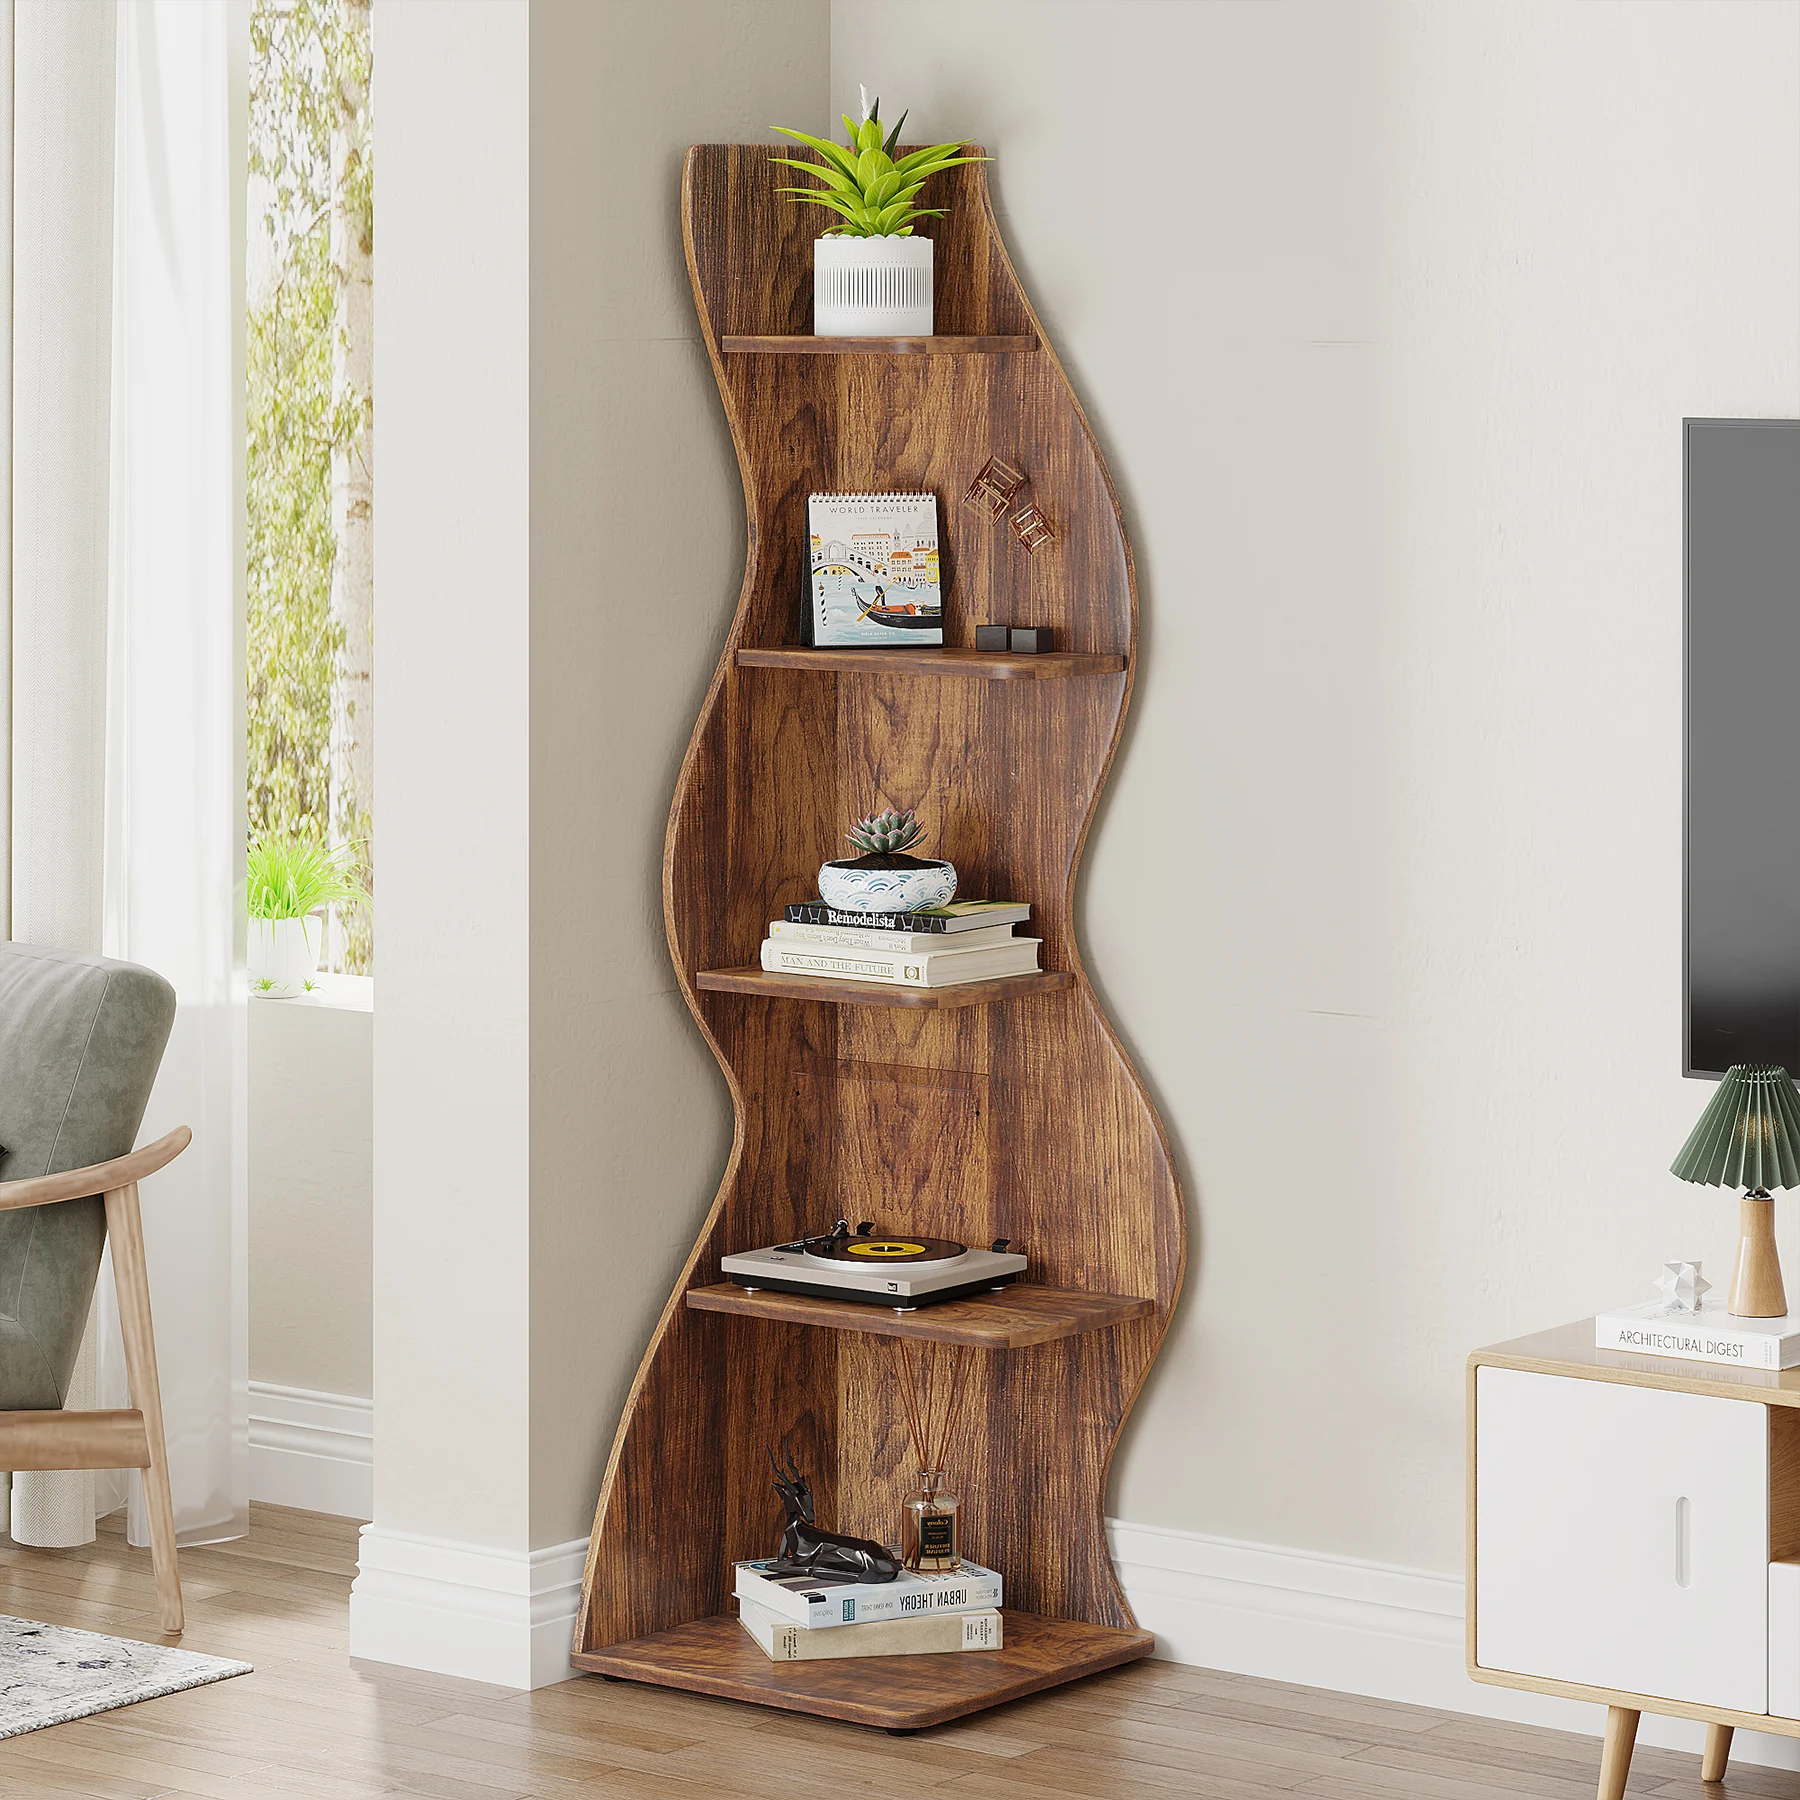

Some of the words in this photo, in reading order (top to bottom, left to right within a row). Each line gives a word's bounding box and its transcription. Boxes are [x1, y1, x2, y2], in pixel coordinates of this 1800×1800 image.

[829, 506, 865, 514] WORLD
[870, 505, 919, 513] TRAVELER
[827, 908, 896, 928] Remodelista
[780, 955, 804, 965] MAN
[806, 958, 828, 968] AND
[830, 960, 852, 971] THE
[854, 963, 894, 975] FUTURE
[1618, 1330, 1704, 1353] ARCHITECTURAL
[1706, 1340, 1745, 1358] DIGEST
